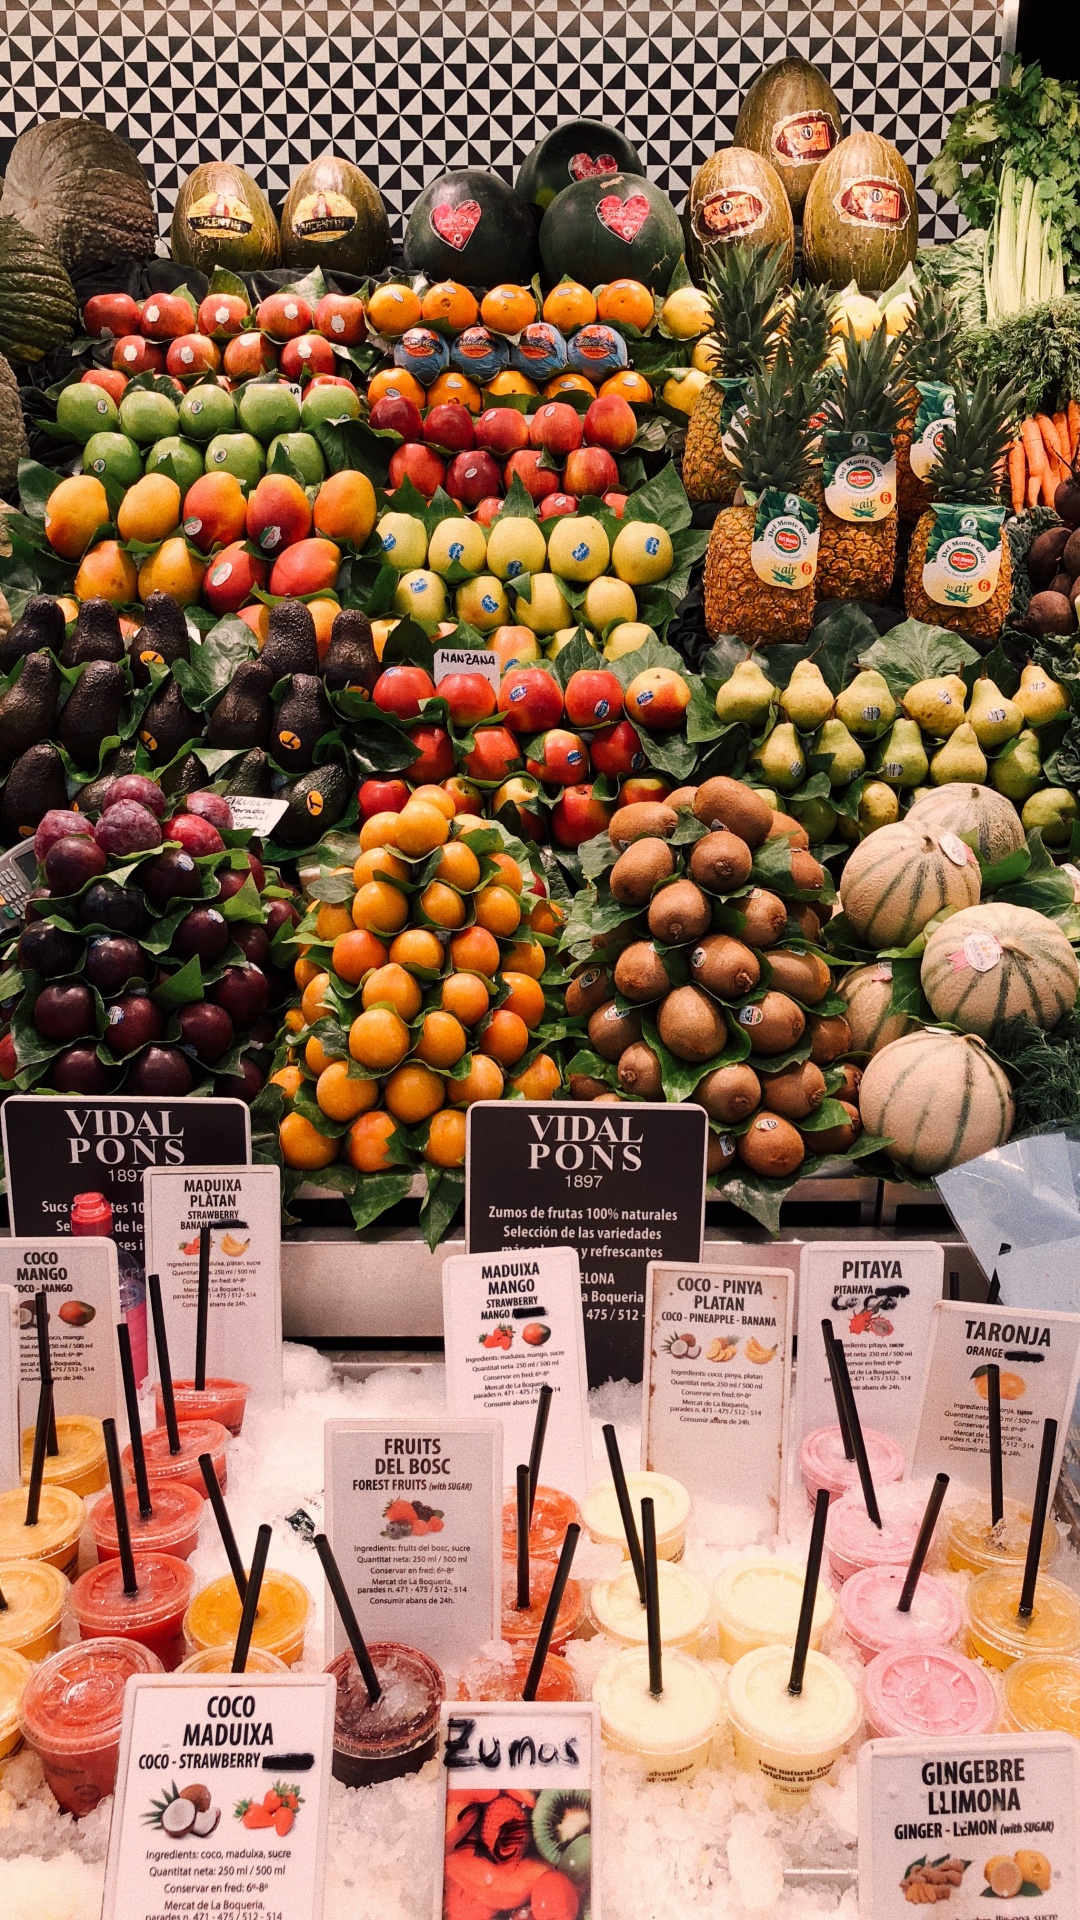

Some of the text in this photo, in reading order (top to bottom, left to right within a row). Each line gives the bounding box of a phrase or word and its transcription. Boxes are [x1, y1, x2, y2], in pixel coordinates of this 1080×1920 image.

[839, 459, 882, 479] Del Monte Gold
[859, 498, 875, 509] air
[768, 520, 808, 546] Del Monte Gold
[941, 540, 986, 564] Del Monte Gold
[781, 563, 797, 575] air
[954, 582, 973, 593] air
[64, 1109, 185, 1137] VIDAL
[528, 1114, 644, 1143] VIDAL
[67, 1138, 186, 1165] PONS
[527, 1143, 643, 1172] PONS
[184, 1179, 242, 1192] MADUIXA
[565, 1174, 603, 1188] 1897
[42, 1200, 68, 1213] Sucs
[190, 1191, 237, 1208] PLÀTAN
[187, 1210, 239, 1220] STRAWBERRY
[488, 1205, 678, 1222] Zumos de frutas 100% naturales
[115, 1220, 129, 1233] de
[503, 1224, 662, 1241] Selección de las variedades
[23, 1251, 59, 1265] COCO
[581, 1248, 589, 1259] y
[590, 1245, 662, 1258] refrescantes
[16, 1267, 68, 1281] MANGO
[481, 1262, 540, 1280] MADUIXA
[842, 1260, 903, 1279] PITAYA
[41, 1284, 73, 1292] MANGO
[487, 1278, 535, 1296] MANGO
[677, 1277, 763, 1295] COCO PINYA
[833, 1285, 873, 1295] PITAHAYA
[486, 1295, 538, 1309] STRAWBERRY
[591, 1291, 644, 1305] Boqueria
[694, 1295, 745, 1312] PLATAN
[480, 1310, 510, 1321] MANGO
[586, 1308, 639, 1321] 475 512
[661, 1311, 777, 1327] COCO PINEAPPLE BANANA
[964, 1320, 1051, 1347] TARONJA
[966, 1345, 1004, 1359] ORANGE
[384, 1438, 442, 1455] FRUITS
[375, 1458, 451, 1475] DEL BOSC
[352, 1479, 473, 1492] FOREST FRUITS (with SUGAR)
[353, 1545, 397, 1553] Ingredients:
[398, 1544, 417, 1552] fruits
[357, 1555, 391, 1564] Quantitat
[357, 1586, 386, 1595] parades
[207, 1695, 256, 1718] COCO
[182, 1722, 274, 1747] MADUIXA
[138, 1752, 261, 1770] COCO STRAWBERRY
[921, 1758, 1025, 1786] GINGEBRE
[928, 1787, 1021, 1816] LLIMONA
[894, 1819, 1055, 1840] GINGER LEMON (with SUGAR)
[145, 1849, 292, 1862] Ingredients: coco, maduixa, sucre
[149, 1865, 286, 1877] Quantitat neta: 250 ml 500 ml
[164, 1883, 209, 1894] Conservar
[210, 1885, 223, 1893] en
[224, 1882, 245, 1893] fred:
[164, 1899, 265, 1912] Mercat de La Boqueria,
